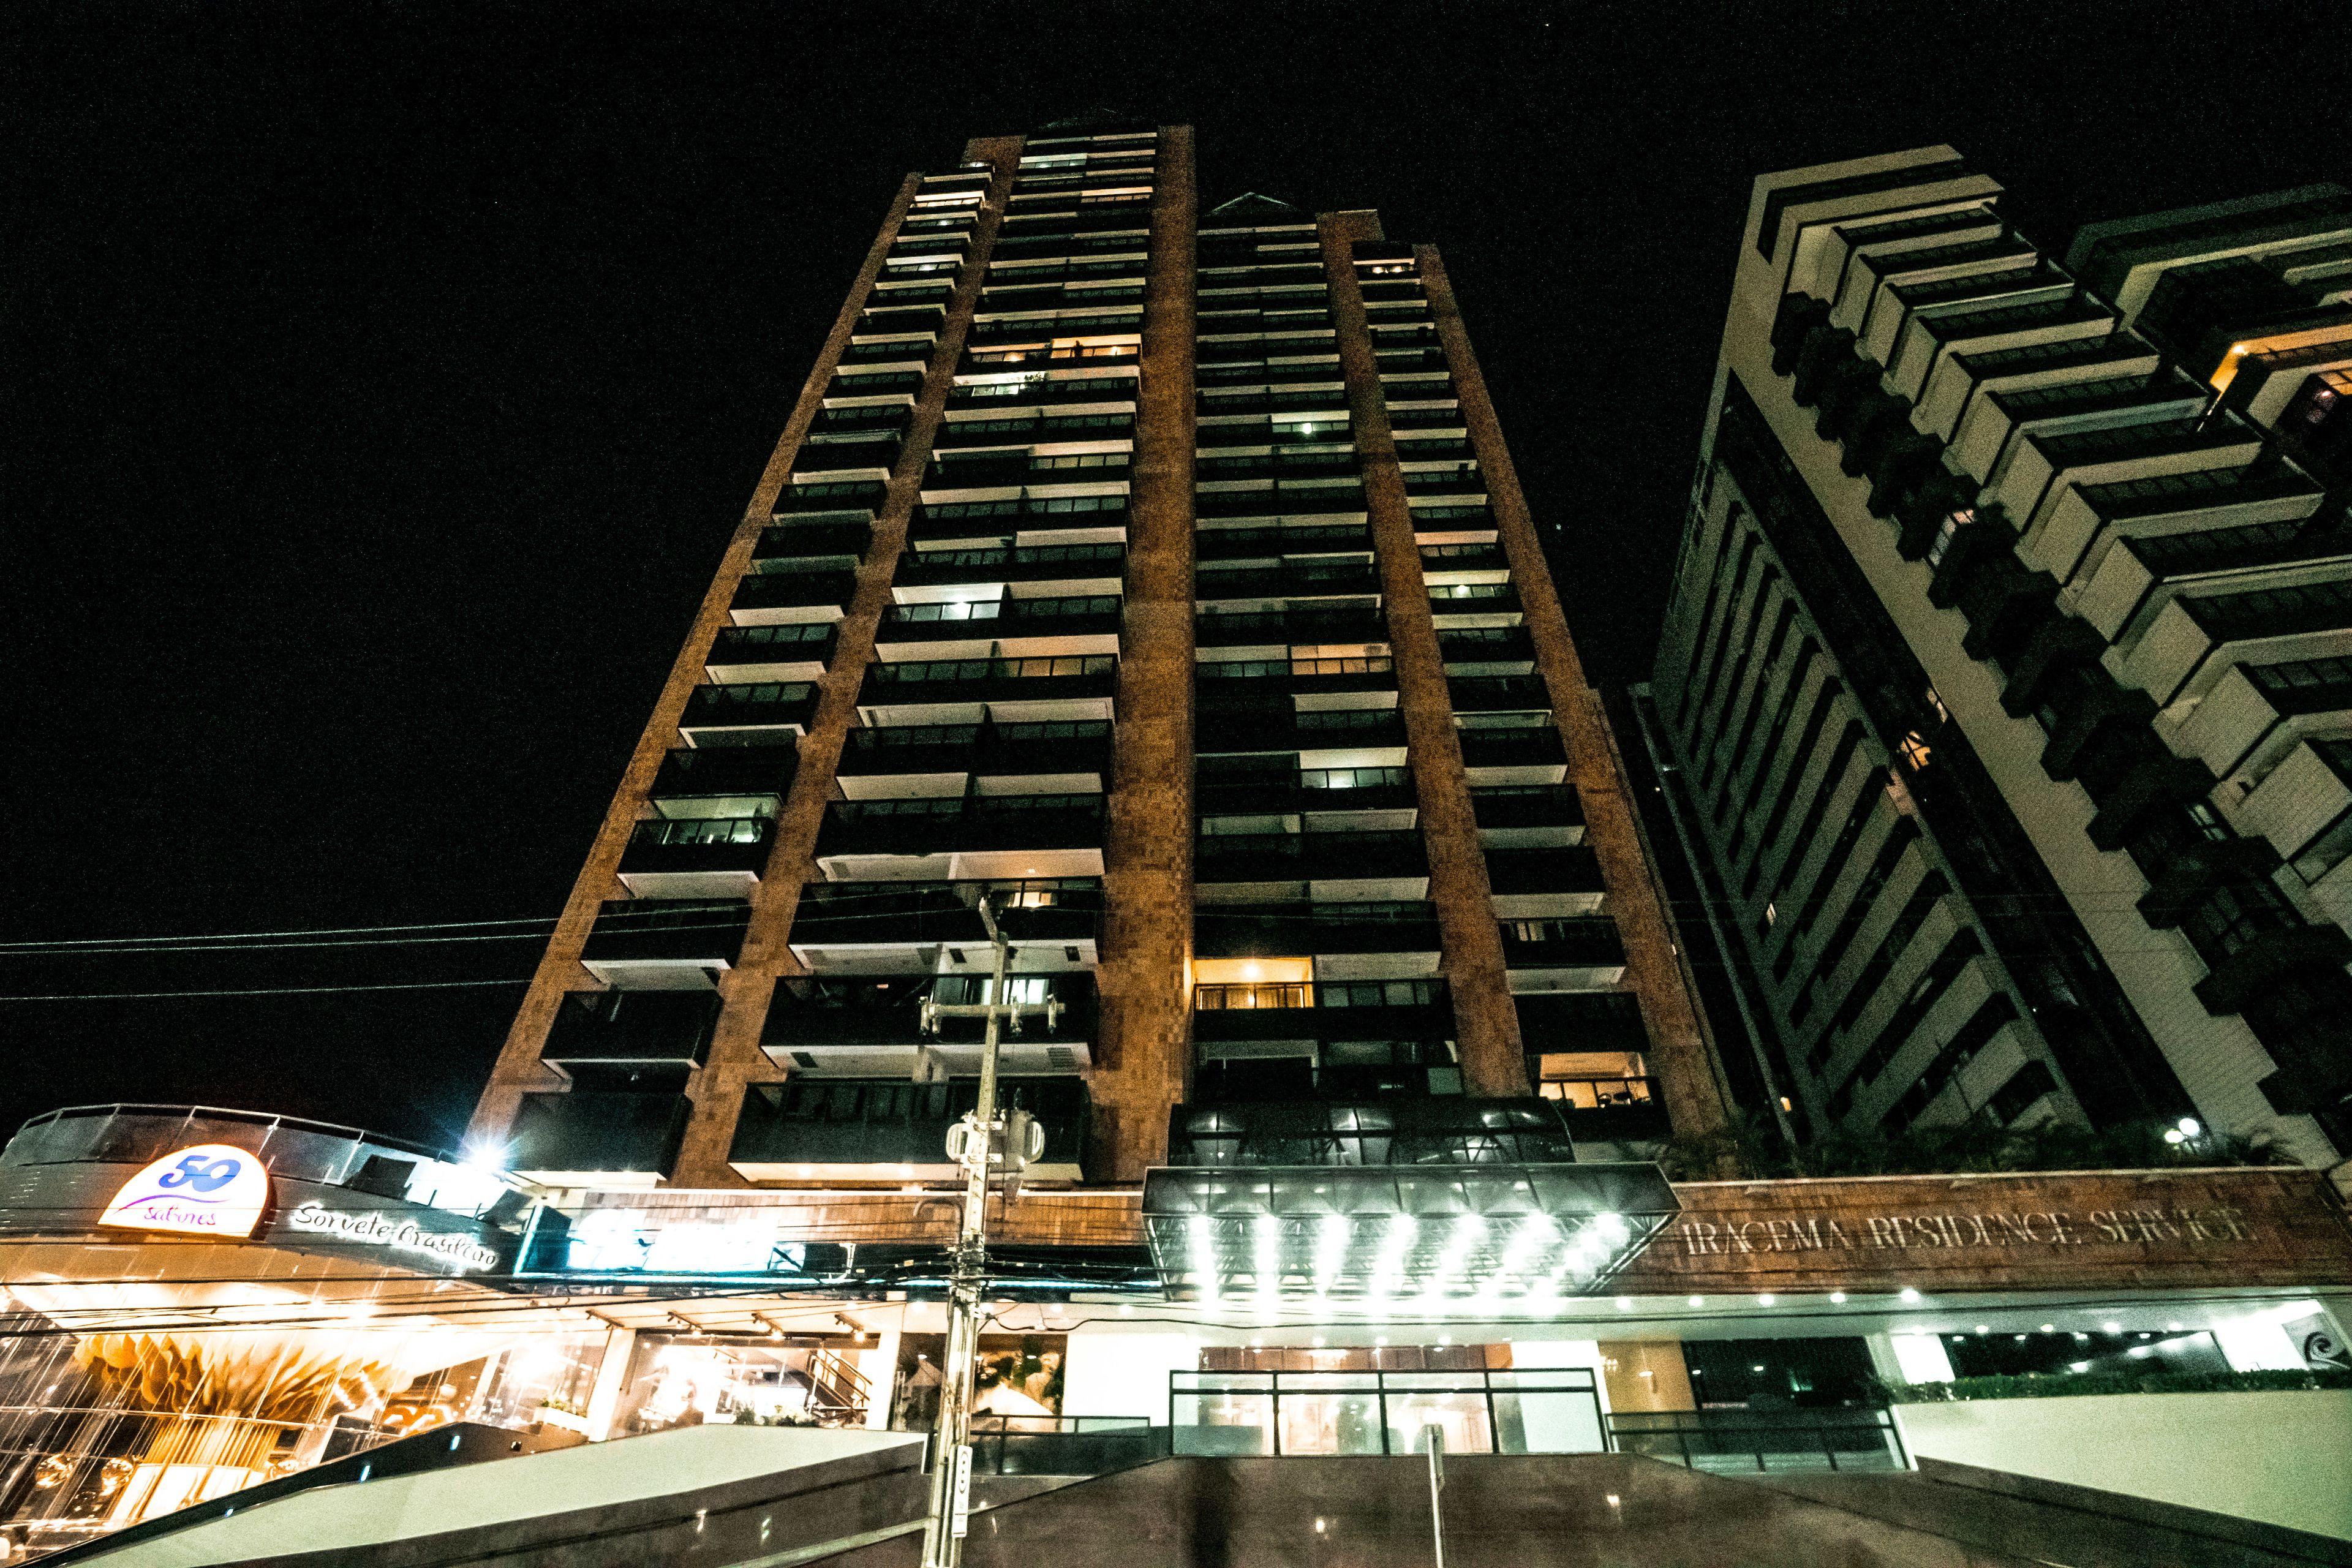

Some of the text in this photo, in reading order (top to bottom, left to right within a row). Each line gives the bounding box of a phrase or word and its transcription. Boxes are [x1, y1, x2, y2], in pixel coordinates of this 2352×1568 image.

[158, 1155, 241, 1192] 50
[295, 1205, 391, 1238] Sorvete
[1681, 1207, 2258, 1256] IRACEMA RESIDENCE SERVICE
